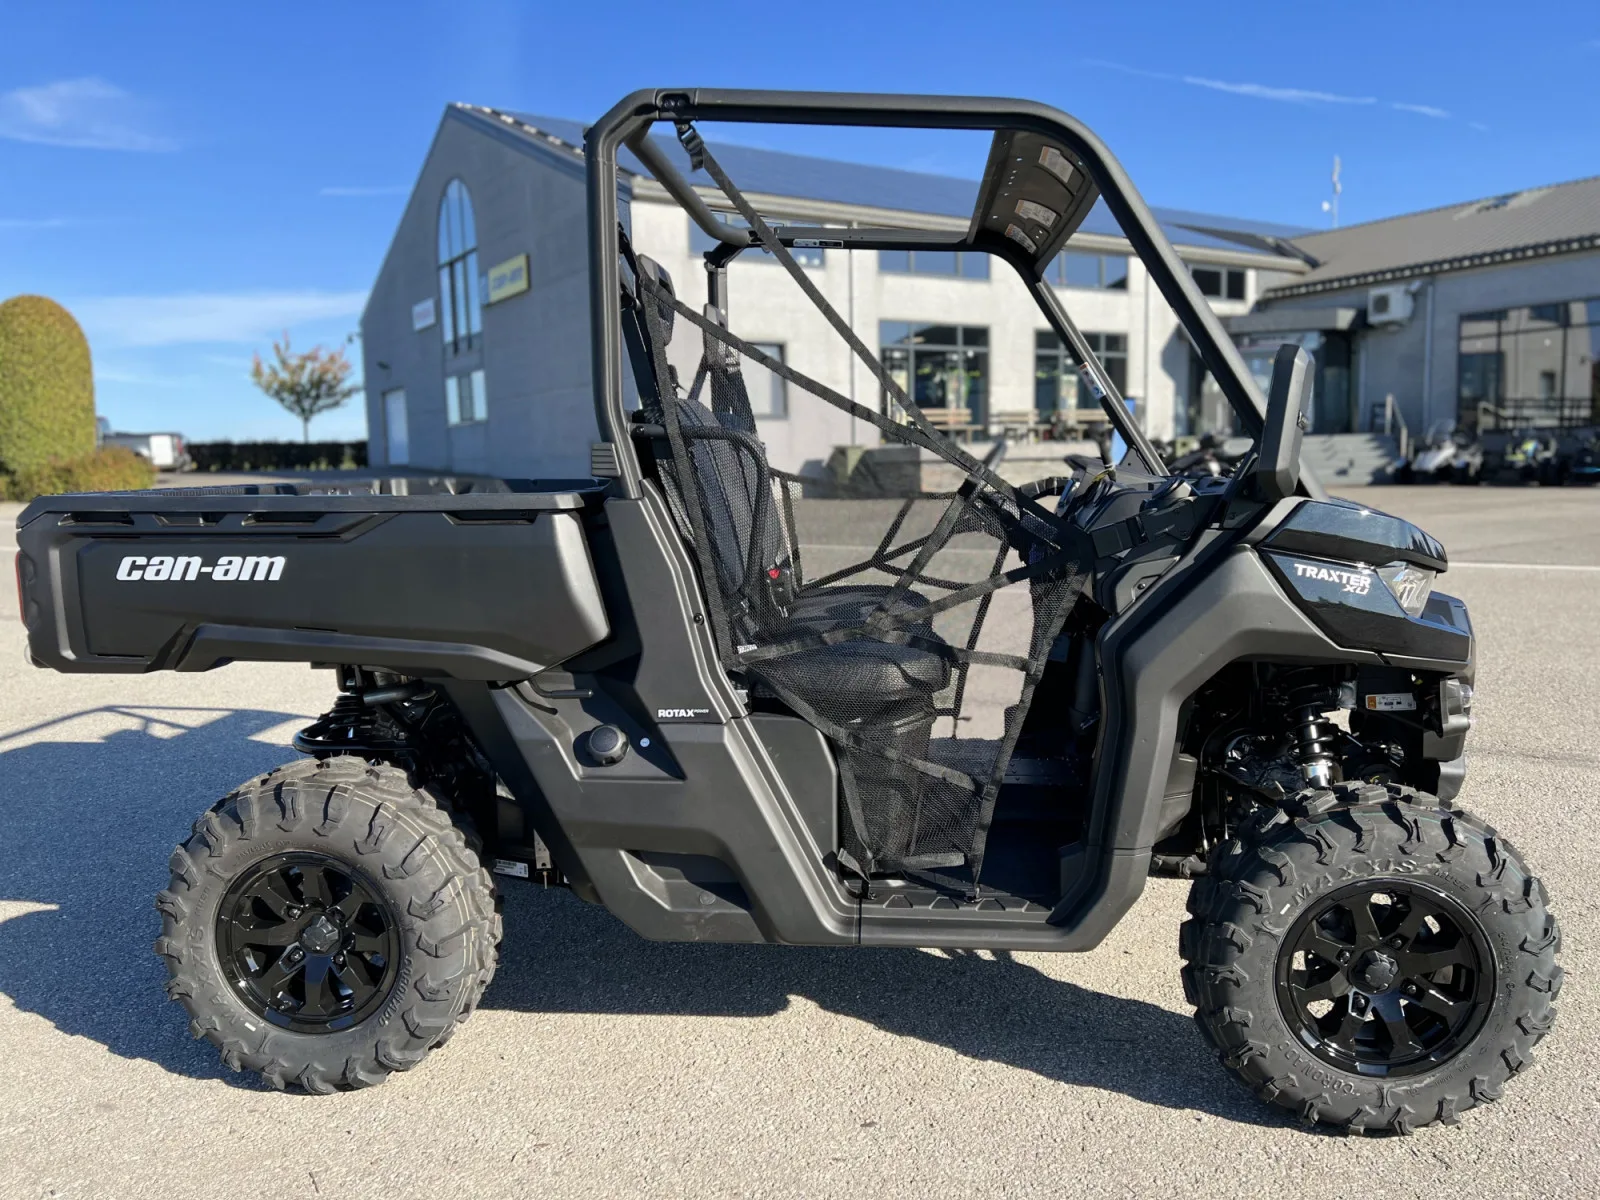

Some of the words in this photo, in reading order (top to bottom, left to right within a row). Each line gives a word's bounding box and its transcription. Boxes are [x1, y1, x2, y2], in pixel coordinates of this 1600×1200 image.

[116, 556, 286, 581] can-am
[1294, 563, 1371, 589] TRAXTER
[657, 709, 694, 718] ROTAX
[1291, 858, 1417, 906] MAXXIS
